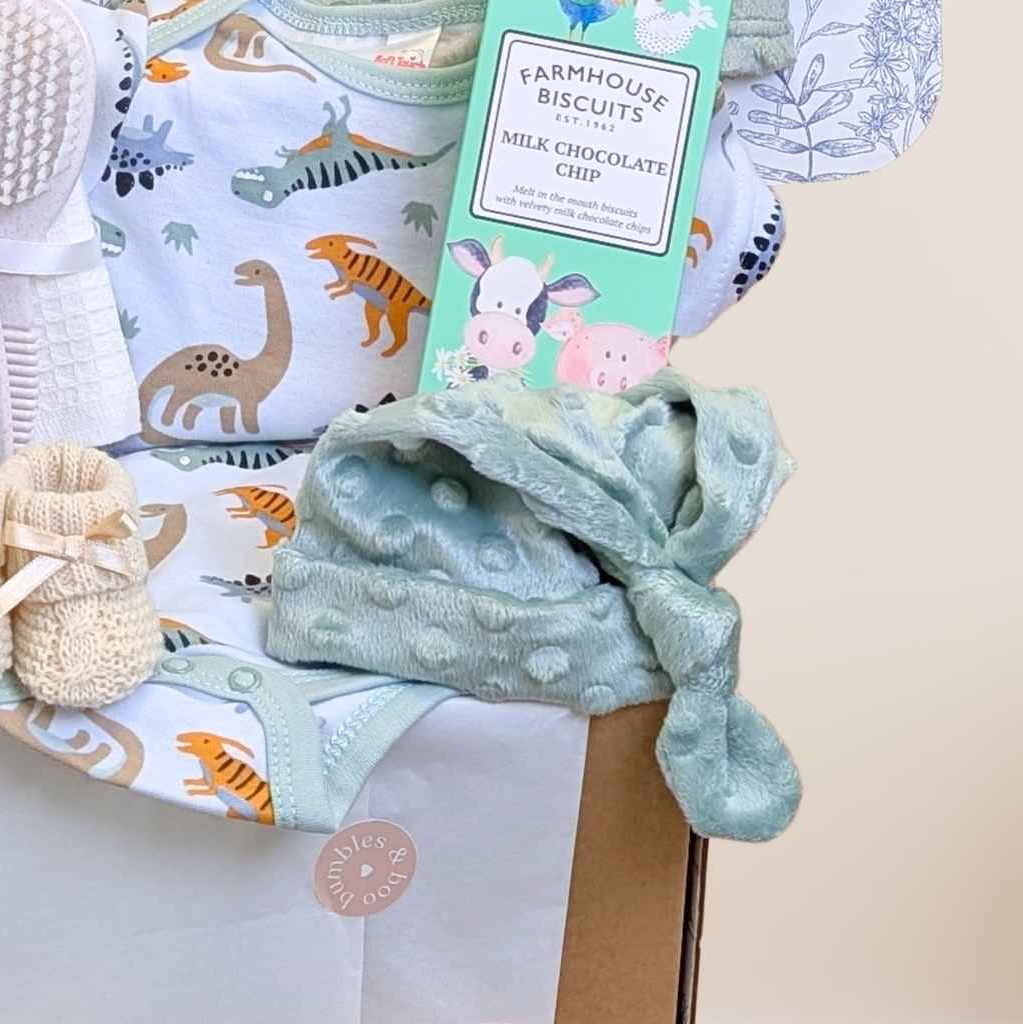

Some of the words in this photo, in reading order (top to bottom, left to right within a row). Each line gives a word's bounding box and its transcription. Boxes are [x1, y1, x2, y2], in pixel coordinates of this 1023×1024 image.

[520, 64, 669, 113] FARMHOUSE
[537, 88, 644, 124] BISCUITS
[501, 130, 550, 153] MILK
[554, 141, 669, 176] CHOCOLATE
[555, 163, 601, 183] CHIP
[495, 195, 517, 206] with
[519, 199, 553, 215] velvety
[554, 207, 575, 219] milk
[577, 211, 624, 228] chocolate
[625, 221, 652, 234] chips
[513, 185, 536, 197] Melt
[537, 189, 548, 199] in
[549, 192, 565, 204] the
[567, 197, 599, 211] mouth
[600, 202, 639, 218] biscuits
[327, 835, 387, 909] bumbles
[389, 847, 407, 865] &
[363, 872, 408, 905] boo
